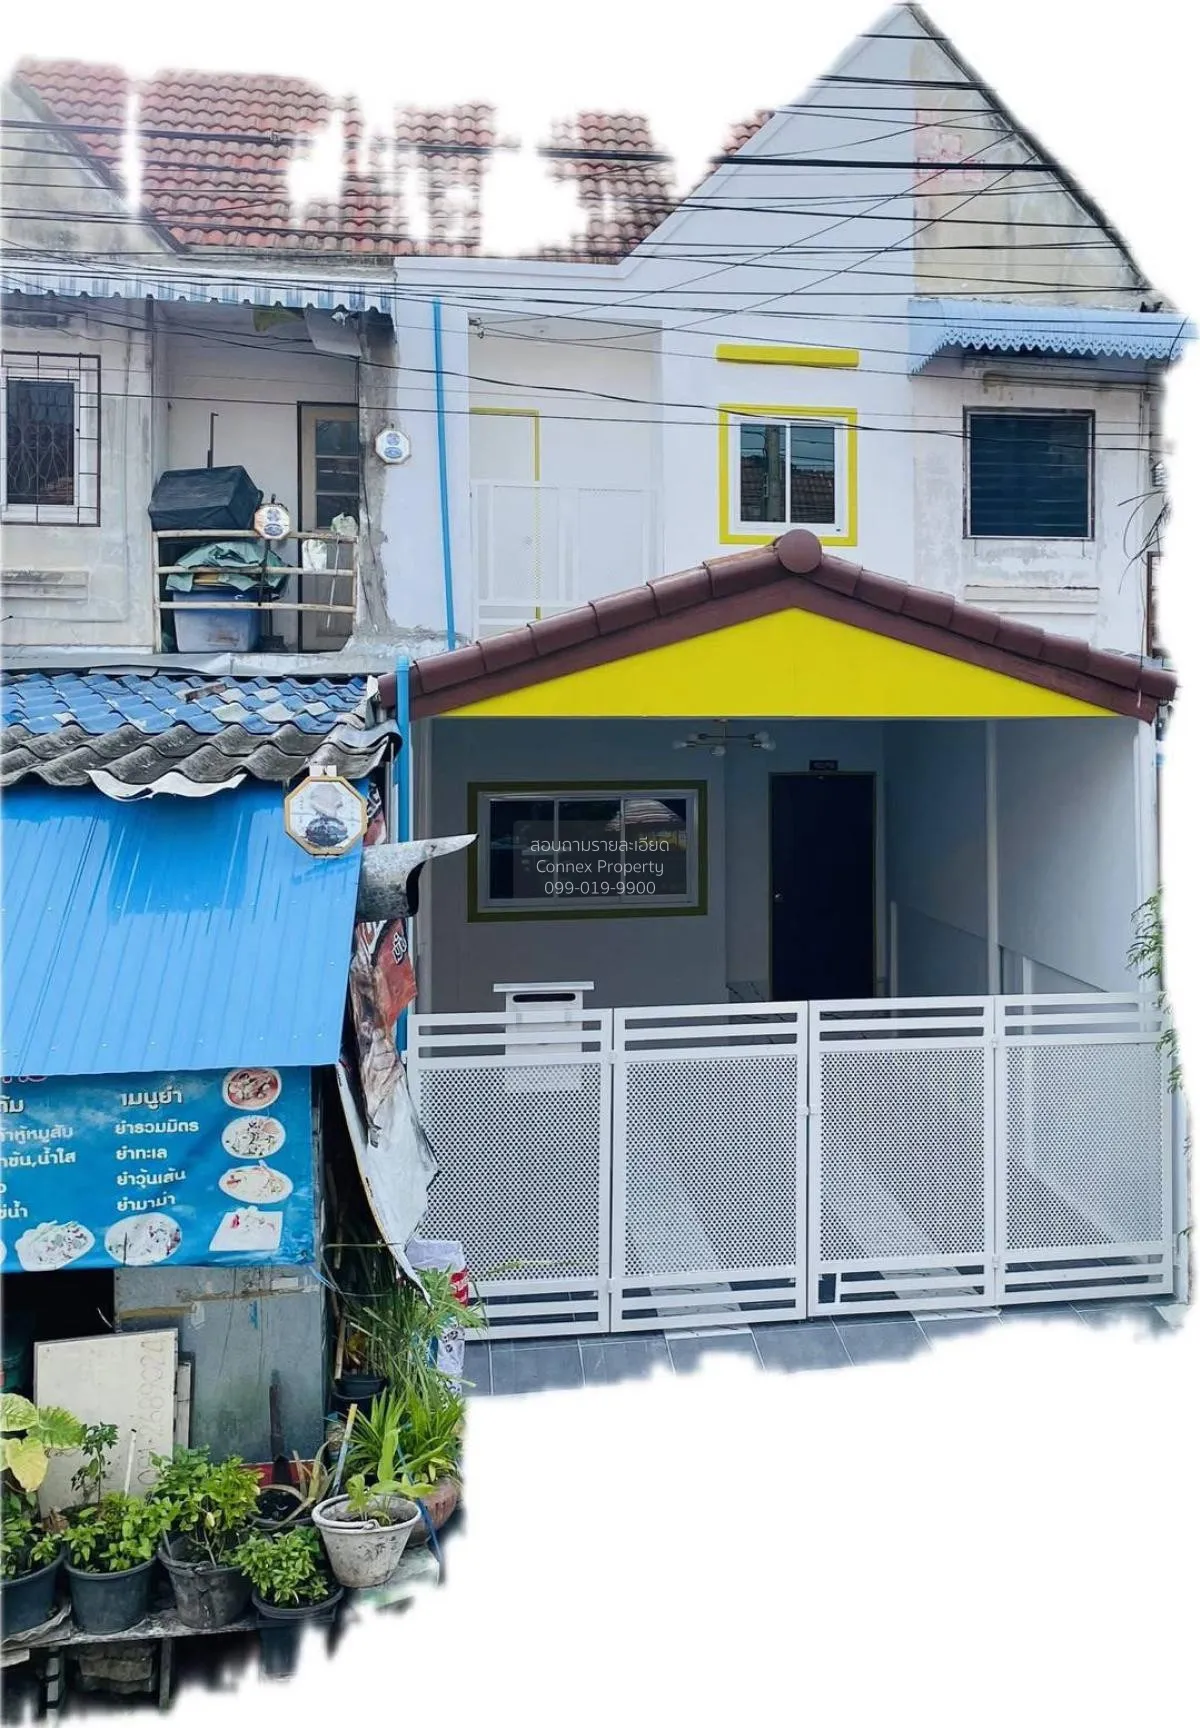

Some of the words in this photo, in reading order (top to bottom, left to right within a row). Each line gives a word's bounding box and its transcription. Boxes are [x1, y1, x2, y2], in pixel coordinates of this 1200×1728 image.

[120, 1085, 183, 1110] เมนูยำ
[115, 1118, 200, 1135] ยำรวมมิตร
[116, 1145, 168, 1160] ยำทะเล
[116, 1167, 187, 1189] ยำวุ้นเส้น
[116, 1191, 176, 1212] ยำมาม่า
